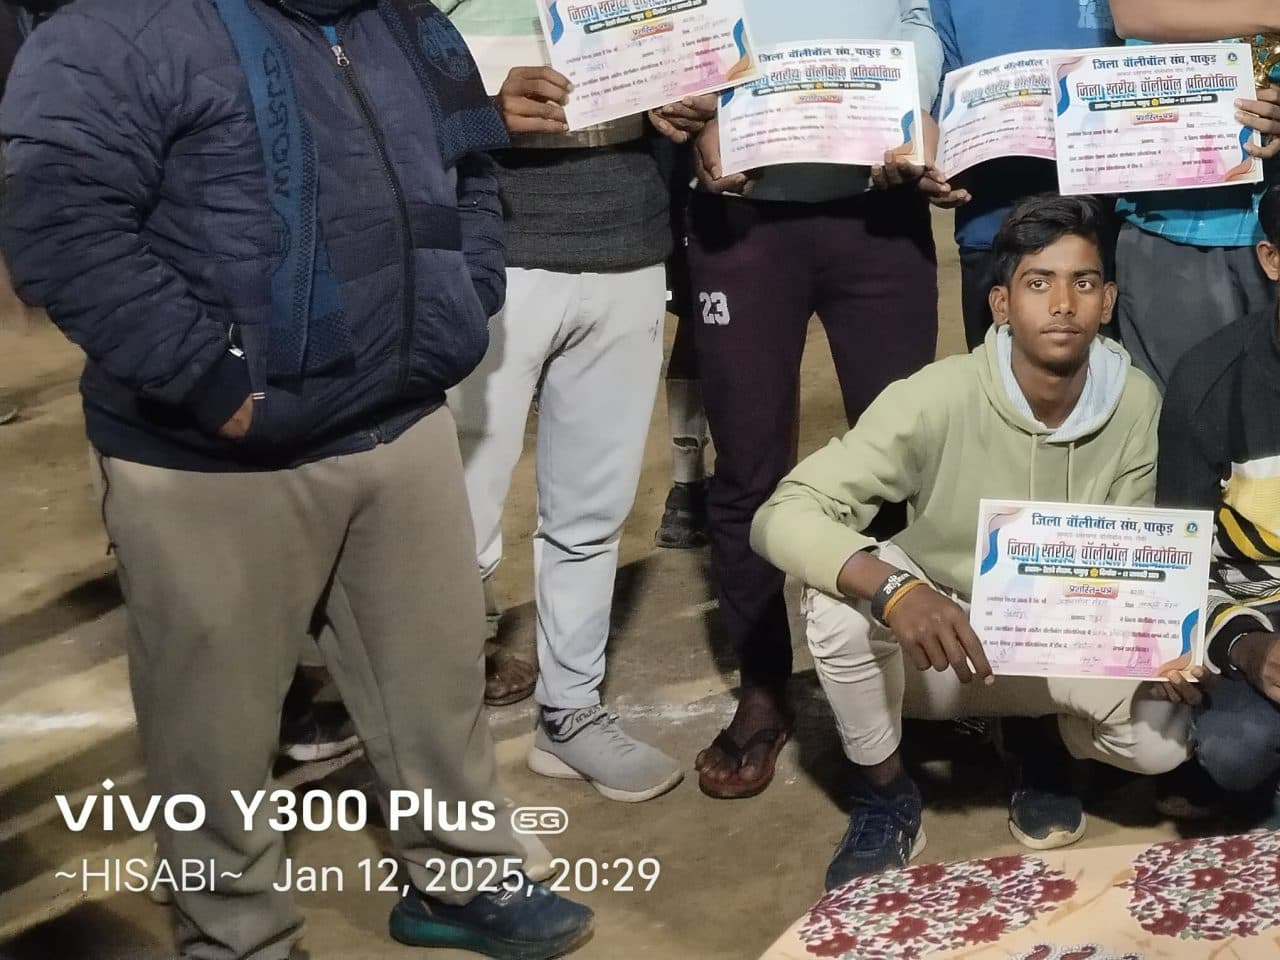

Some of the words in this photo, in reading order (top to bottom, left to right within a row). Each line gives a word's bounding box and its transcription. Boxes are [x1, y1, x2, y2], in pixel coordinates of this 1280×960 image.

[568, 3, 596, 23] जिला
[759, 53, 784, 64] जिला
[1092, 59, 1119, 70] जिला
[1076, 82, 1101, 97] जिला
[1106, 80, 1135, 95] स्तरीय
[1186, 73, 1238, 90] प्रतियोगिता
[699, 292, 730, 325] 23
[1032, 512, 1061, 528] जिला
[1066, 514, 1116, 530] वॉलीबॉल
[1120, 518, 1141, 534] संघ,
[1007, 539, 1036, 557] जिला
[1041, 541, 1075, 560] स्तरीय
[1133, 545, 1192, 566] प्रतियोगिता
